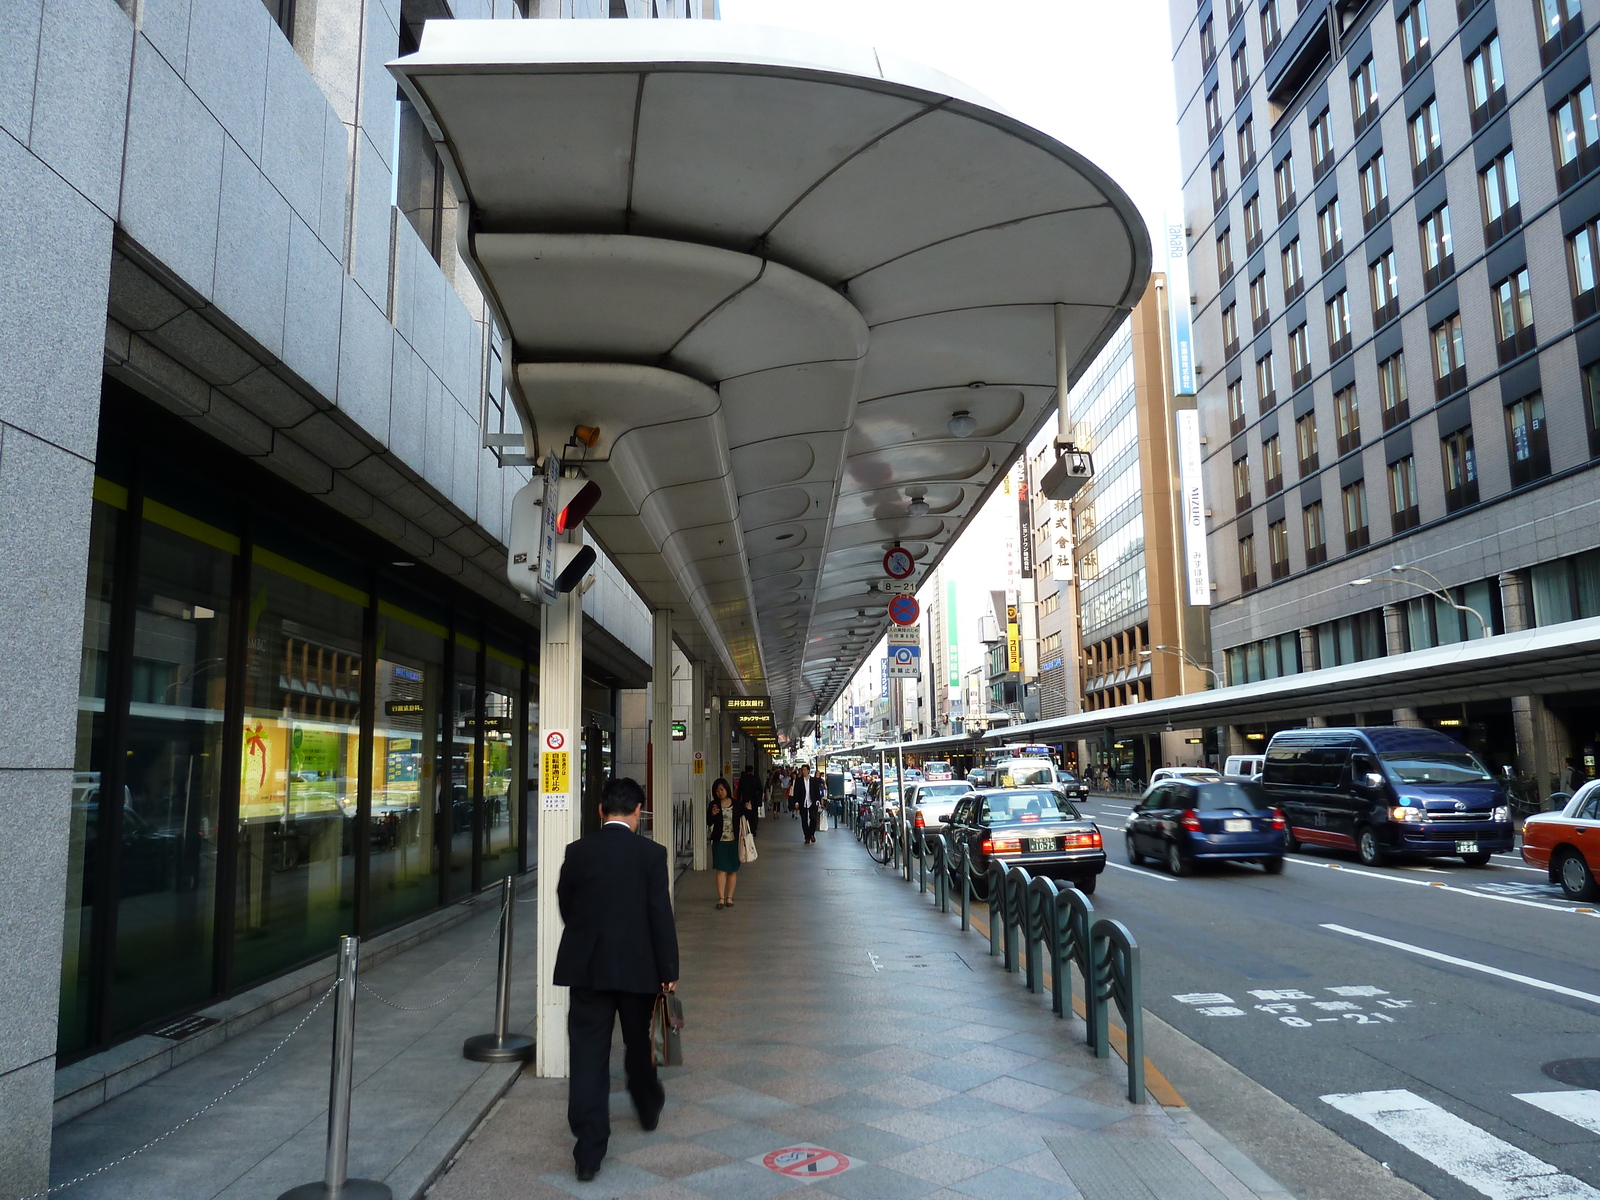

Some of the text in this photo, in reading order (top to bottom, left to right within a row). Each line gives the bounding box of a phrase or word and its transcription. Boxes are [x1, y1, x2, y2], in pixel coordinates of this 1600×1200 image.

[1168, 223, 1183, 258] TaKaRa
[1018, 483, 1028, 501] ONE
[1191, 487, 1201, 527] MIZUHO
[1193, 551, 1204, 595] みずほ銀行
[551, 753, 560, 791] 自転車通行止め
